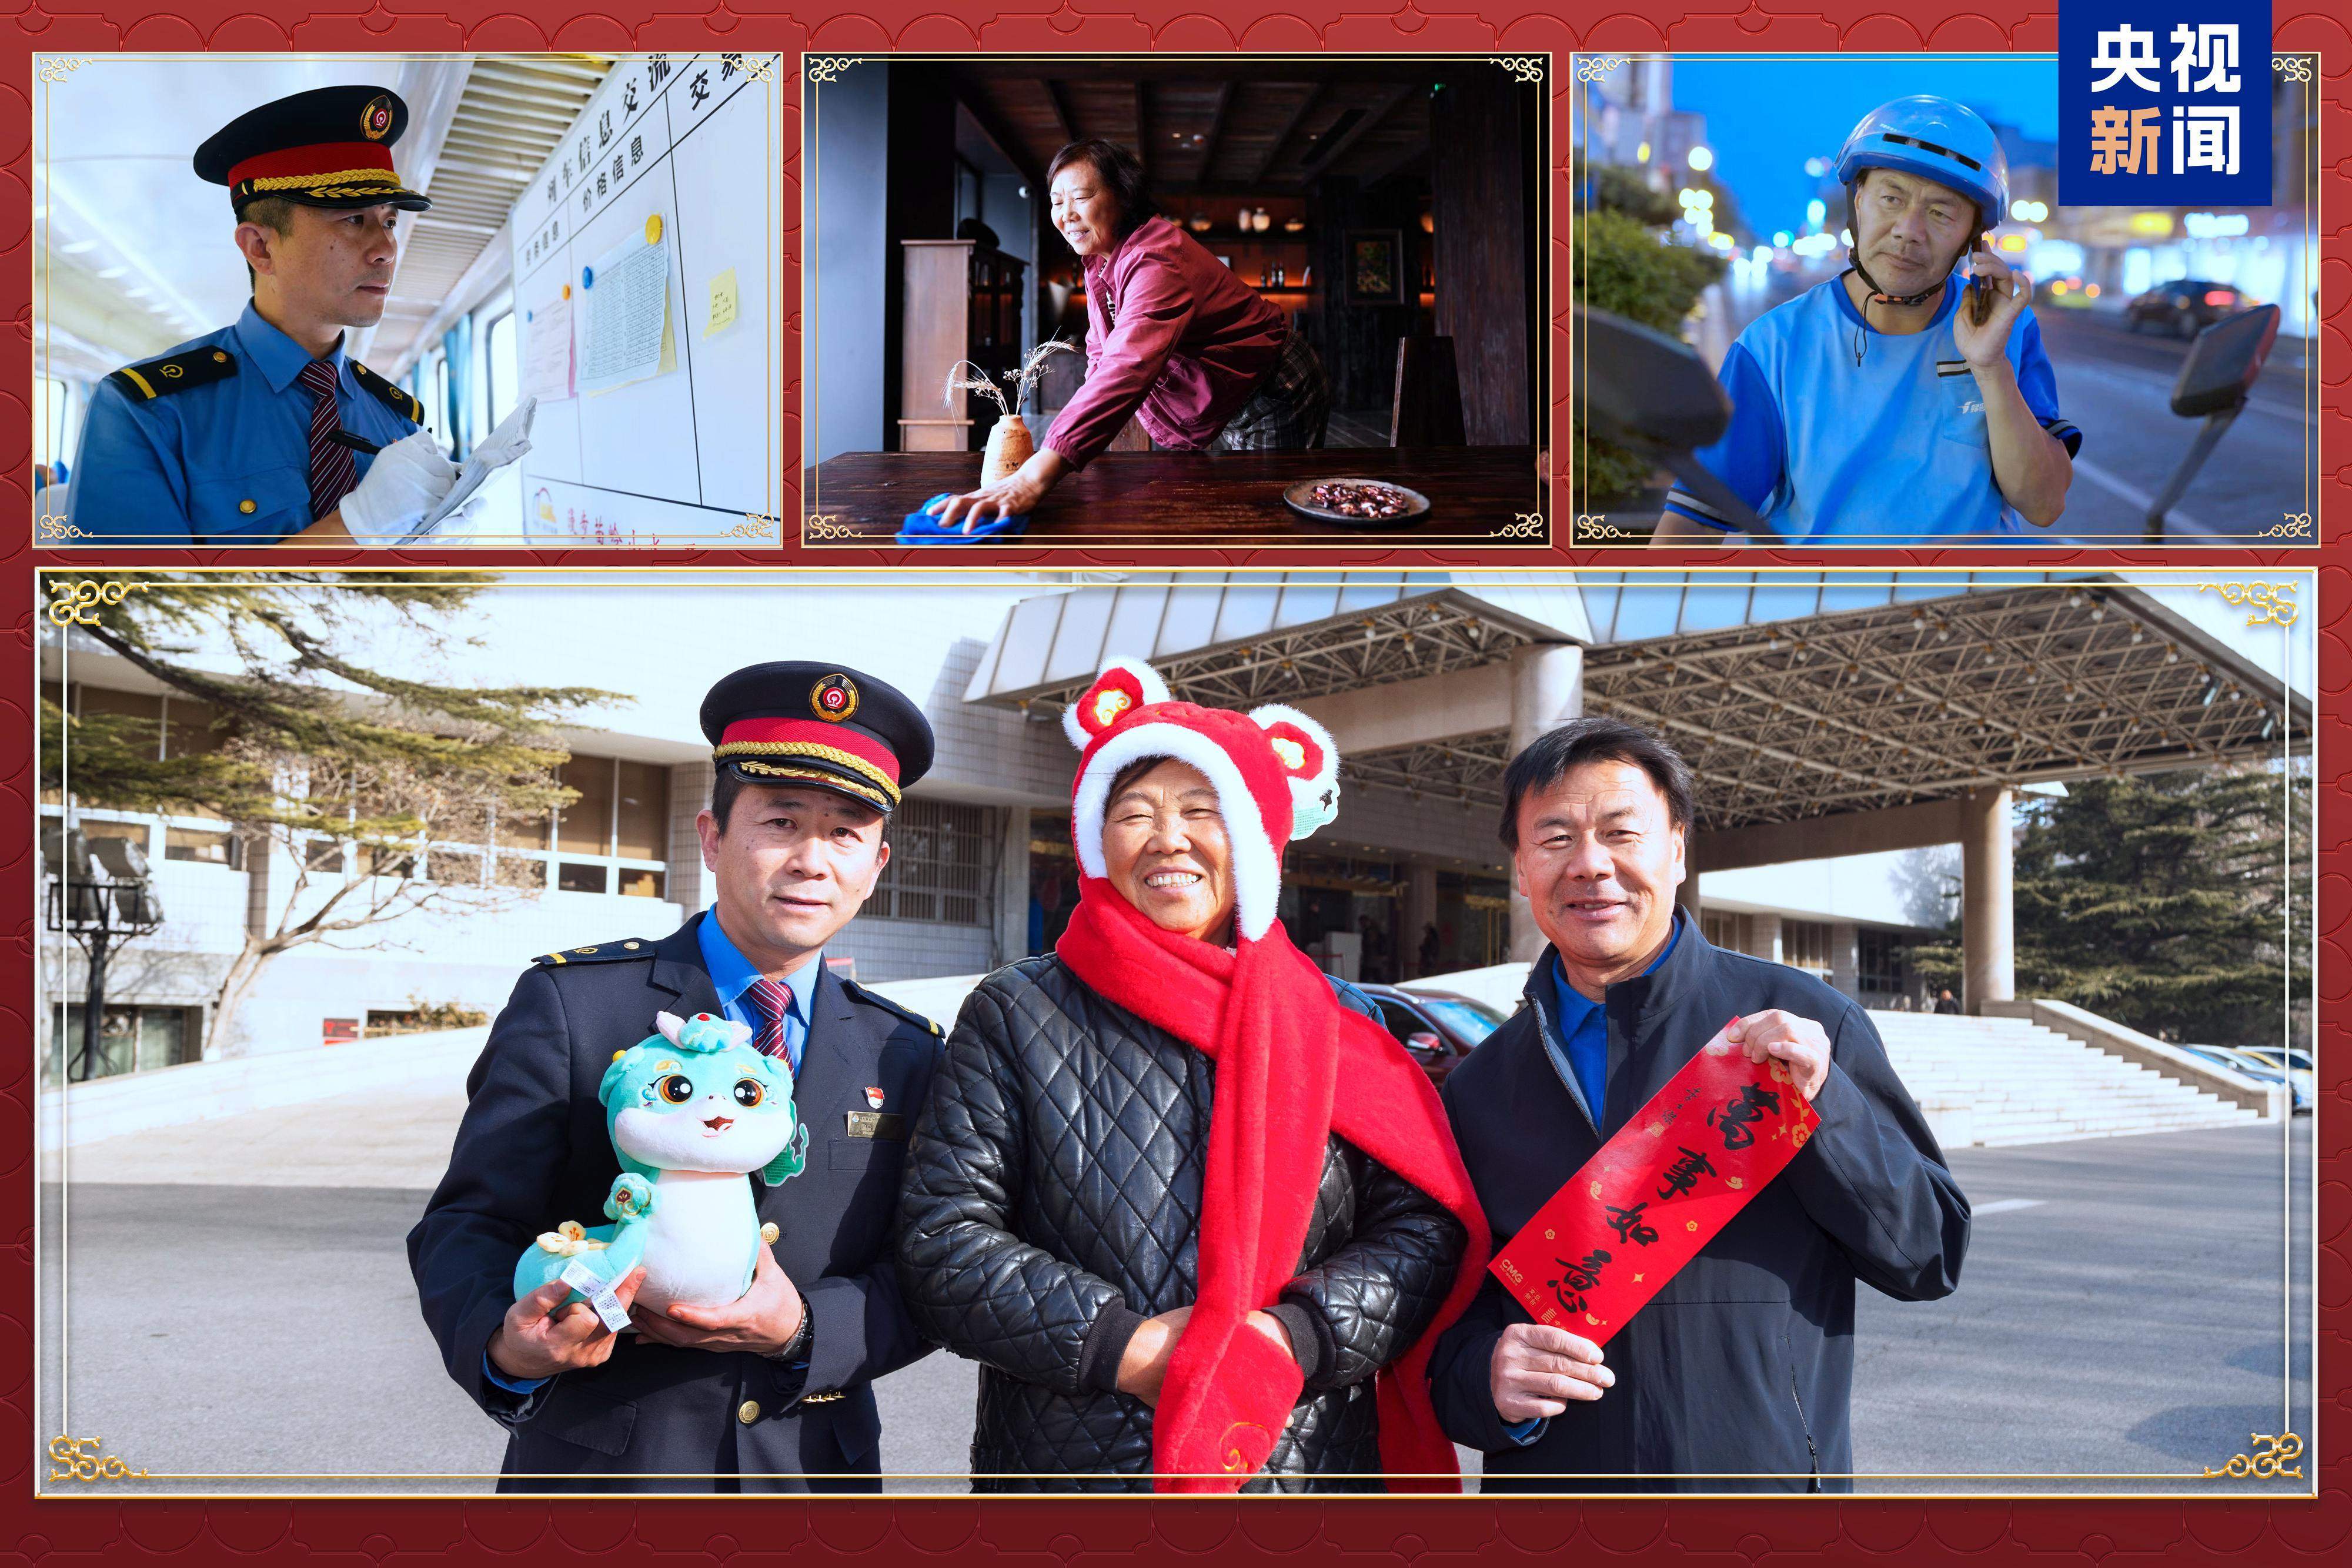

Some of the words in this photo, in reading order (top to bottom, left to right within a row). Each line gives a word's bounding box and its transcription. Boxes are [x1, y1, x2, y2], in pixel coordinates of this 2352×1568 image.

[583, 135, 644, 213] 价格信息
[1502, 1259, 1524, 1283] CMG
